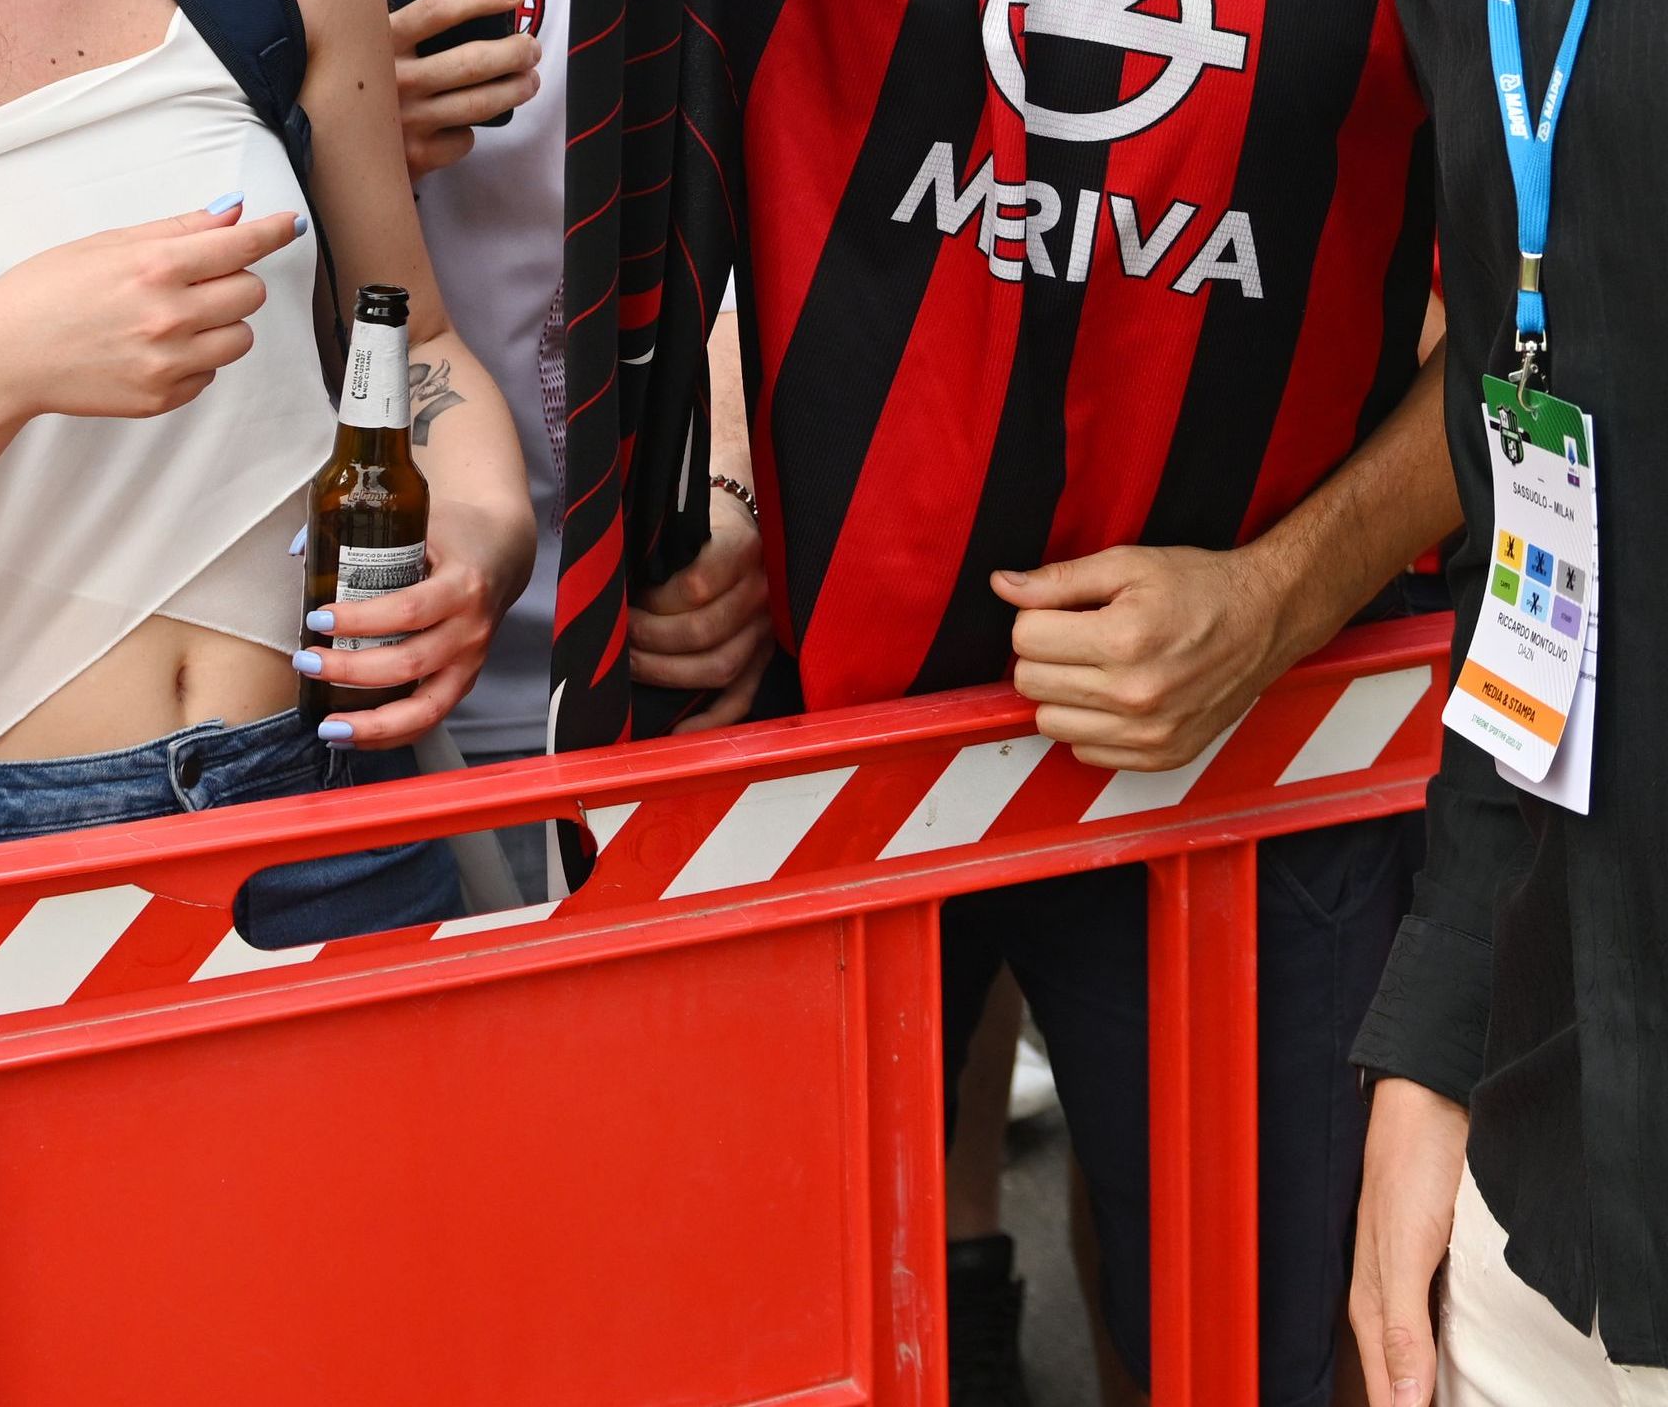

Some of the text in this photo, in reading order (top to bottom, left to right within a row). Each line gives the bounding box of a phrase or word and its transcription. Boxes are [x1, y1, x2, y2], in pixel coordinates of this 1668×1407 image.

[1504, 92, 1527, 137] MAPEI
[1543, 69, 1564, 120] MAPEI
[889, 140, 1265, 300] MERIVA
[1512, 481, 1548, 509] SASSUOLO
[1553, 501, 1575, 523] MILAN
[1497, 612, 1530, 640] RICCARDO
[1530, 631, 1568, 662] MONTOLIVO
[1517, 643, 1534, 662] DAZN
[1482, 681, 1503, 703] MEDIA
[1508, 697, 1536, 723] STAMPA
